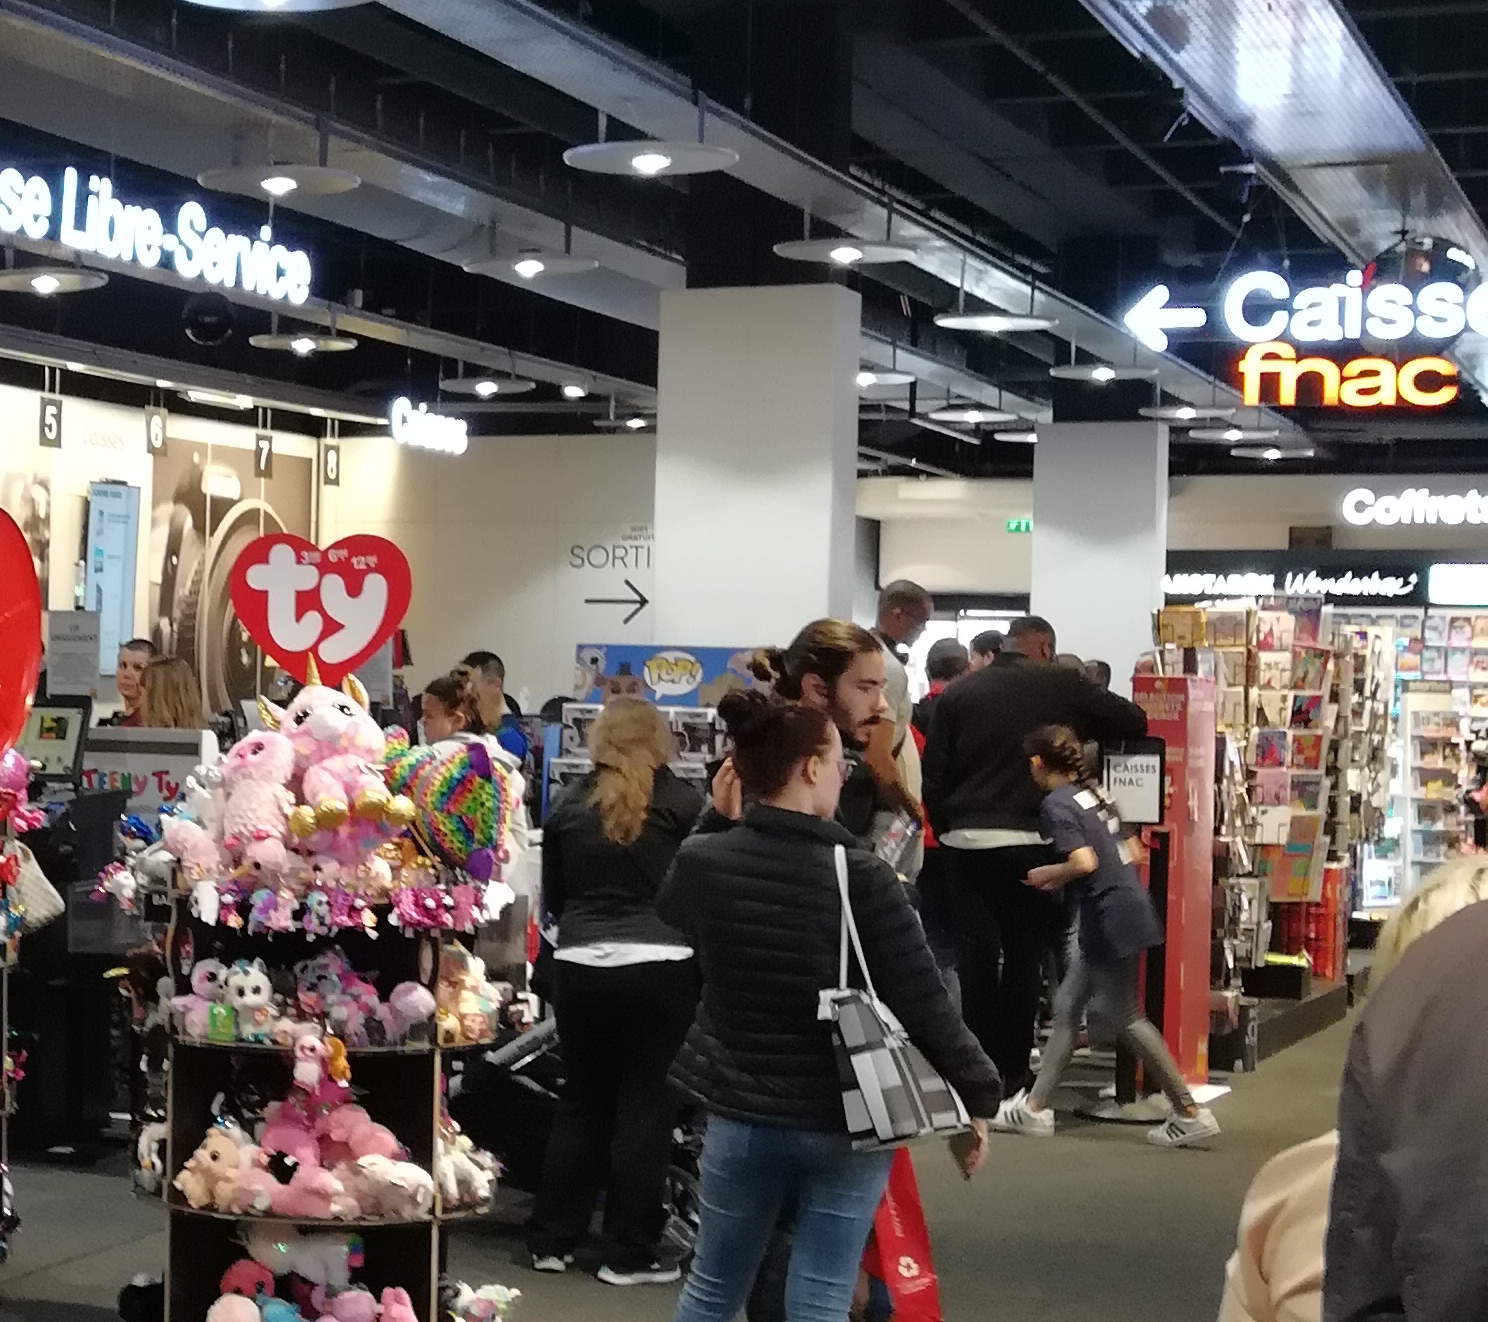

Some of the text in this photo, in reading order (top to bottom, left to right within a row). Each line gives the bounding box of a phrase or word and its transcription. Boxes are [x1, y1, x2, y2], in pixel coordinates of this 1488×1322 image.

[60, 166, 312, 305] Libre-Service
[1239, 341, 1459, 407] fnac
[44, 405, 58, 440] 5
[150, 414, 164, 448] 6
[258, 439, 271, 471] 7
[326, 449, 338, 480] 8
[569, 544, 651, 569] SORTI
[245, 543, 388, 665] ty
[1113, 764, 1157, 775] CAISSES
[1113, 777, 1144, 788] FNAC
